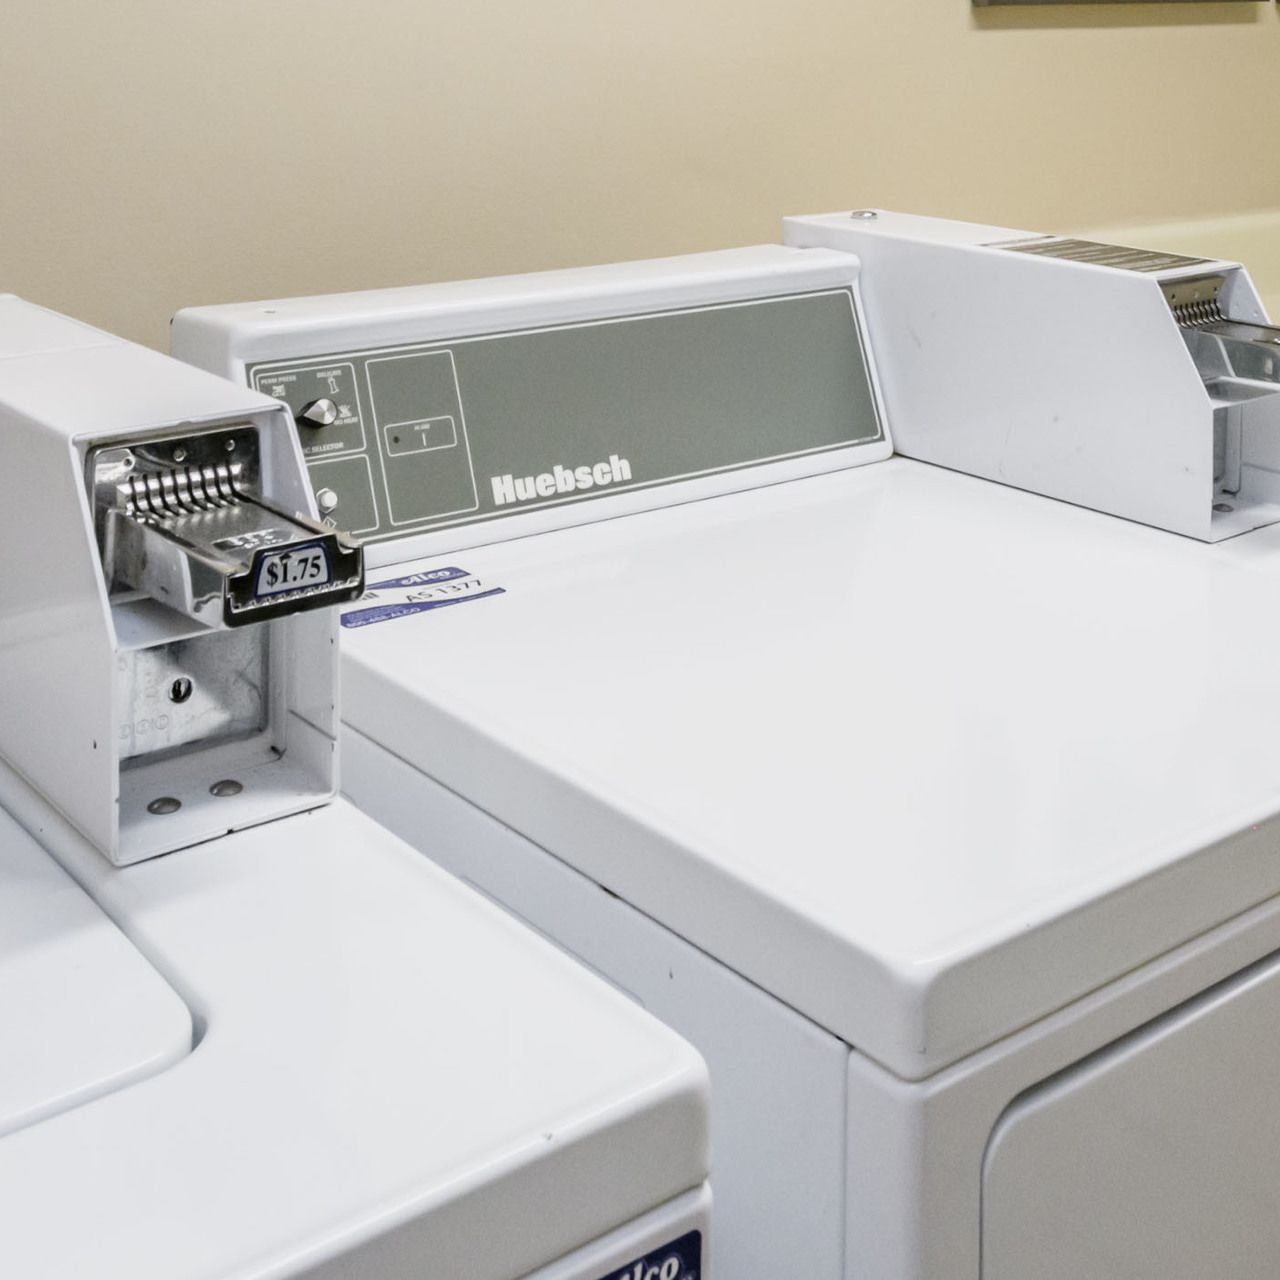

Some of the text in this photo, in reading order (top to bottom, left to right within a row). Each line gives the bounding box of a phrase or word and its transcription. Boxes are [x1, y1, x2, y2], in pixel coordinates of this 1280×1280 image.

[490, 454, 632, 506] Huebsch
[266, 555, 323, 588] $1.75
[401, 571, 451, 586] Alco
